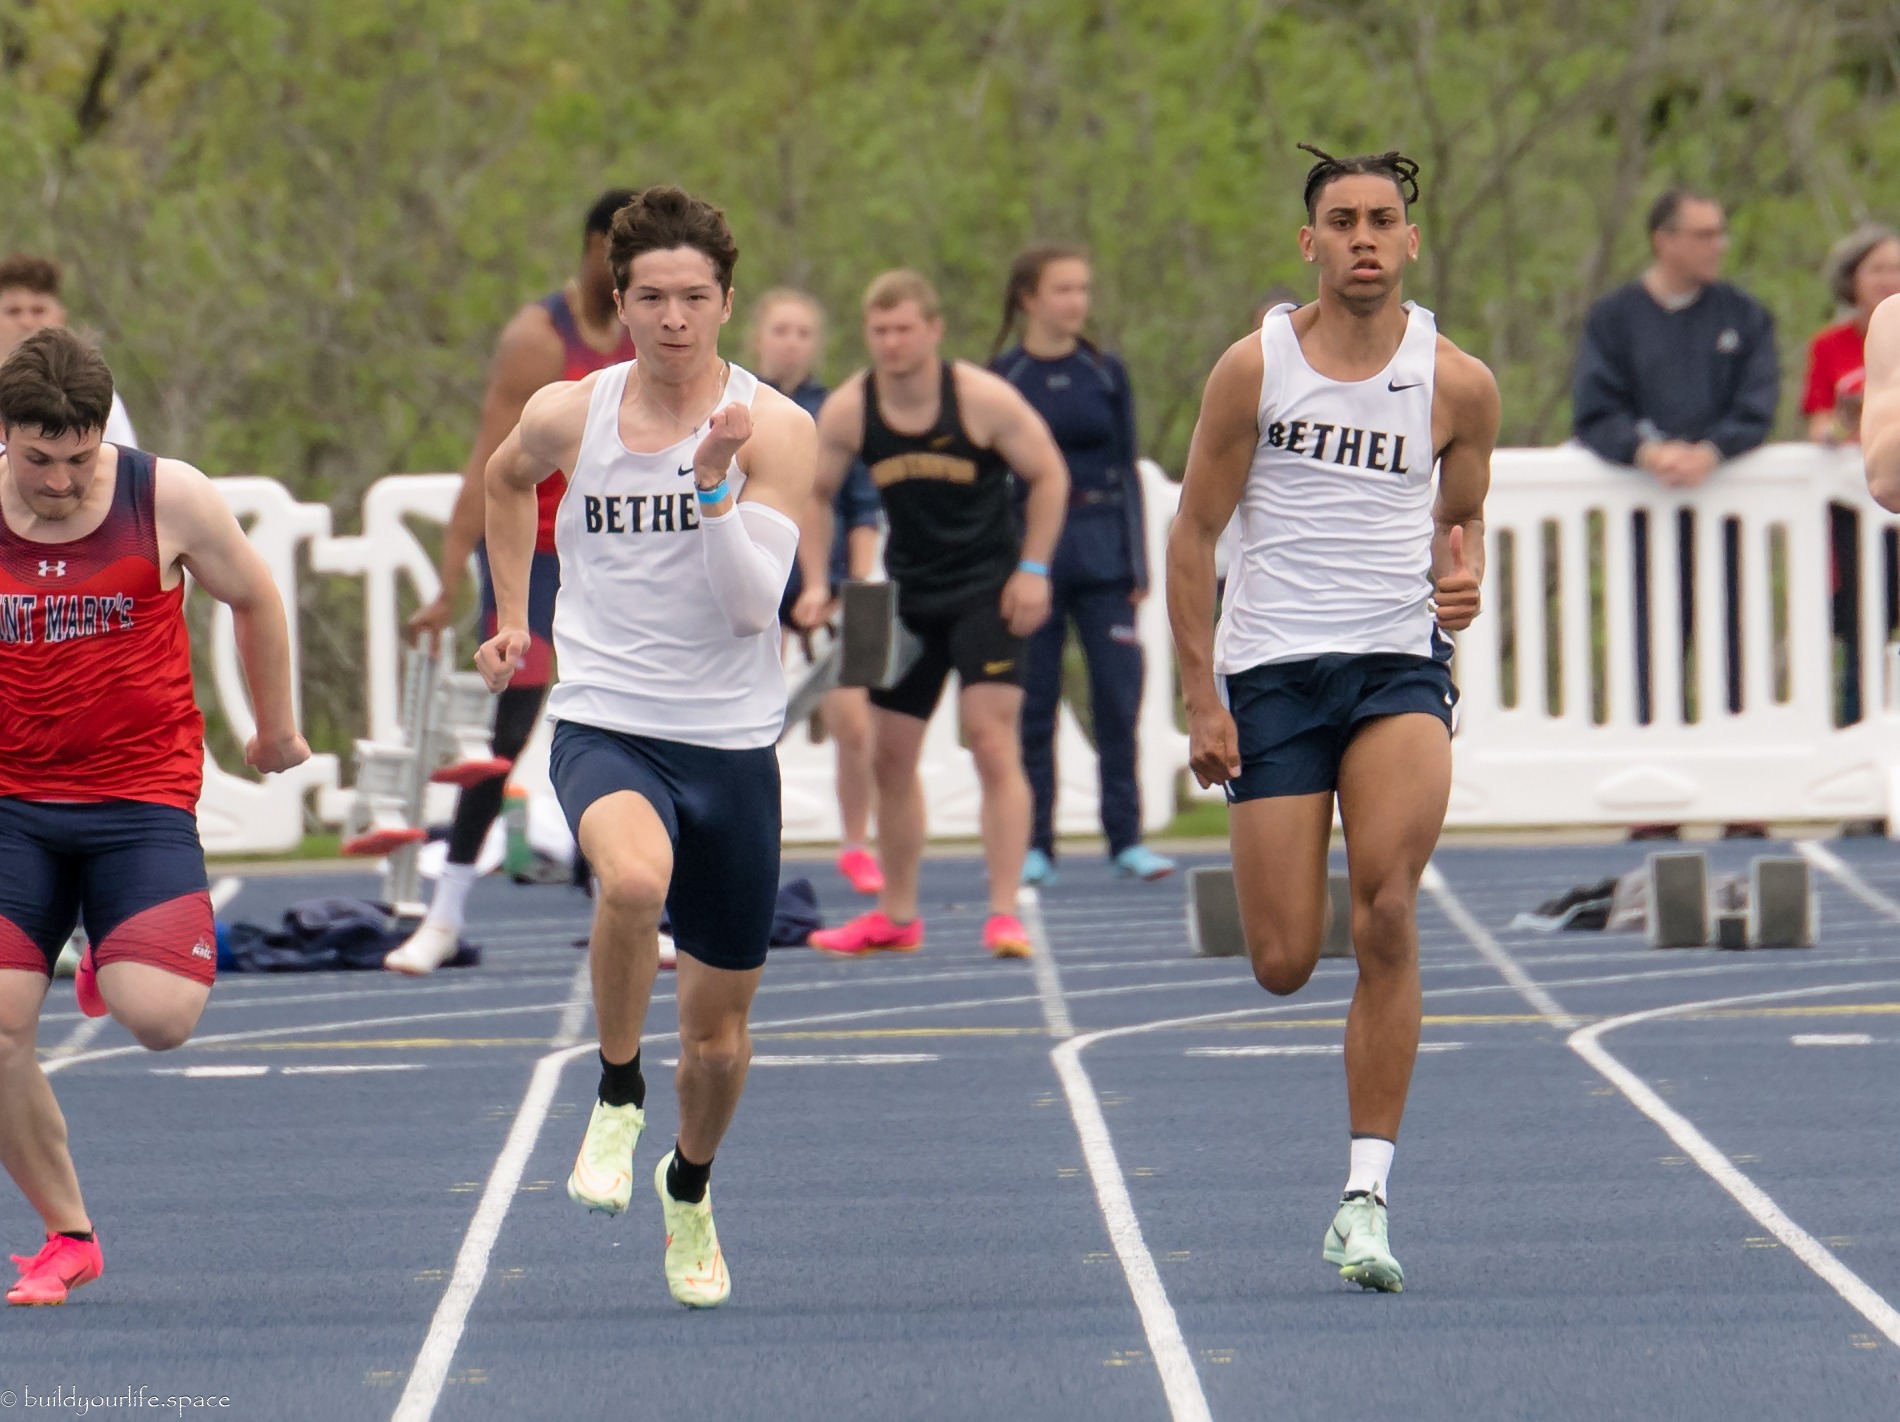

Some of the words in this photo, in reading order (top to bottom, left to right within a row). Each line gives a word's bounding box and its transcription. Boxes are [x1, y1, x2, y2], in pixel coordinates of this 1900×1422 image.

[1268, 420, 1411, 475] BETHEL
[584, 492, 700, 534] BETHE
[0, 594, 37, 643] NT
[44, 592, 134, 643] MARY'S
